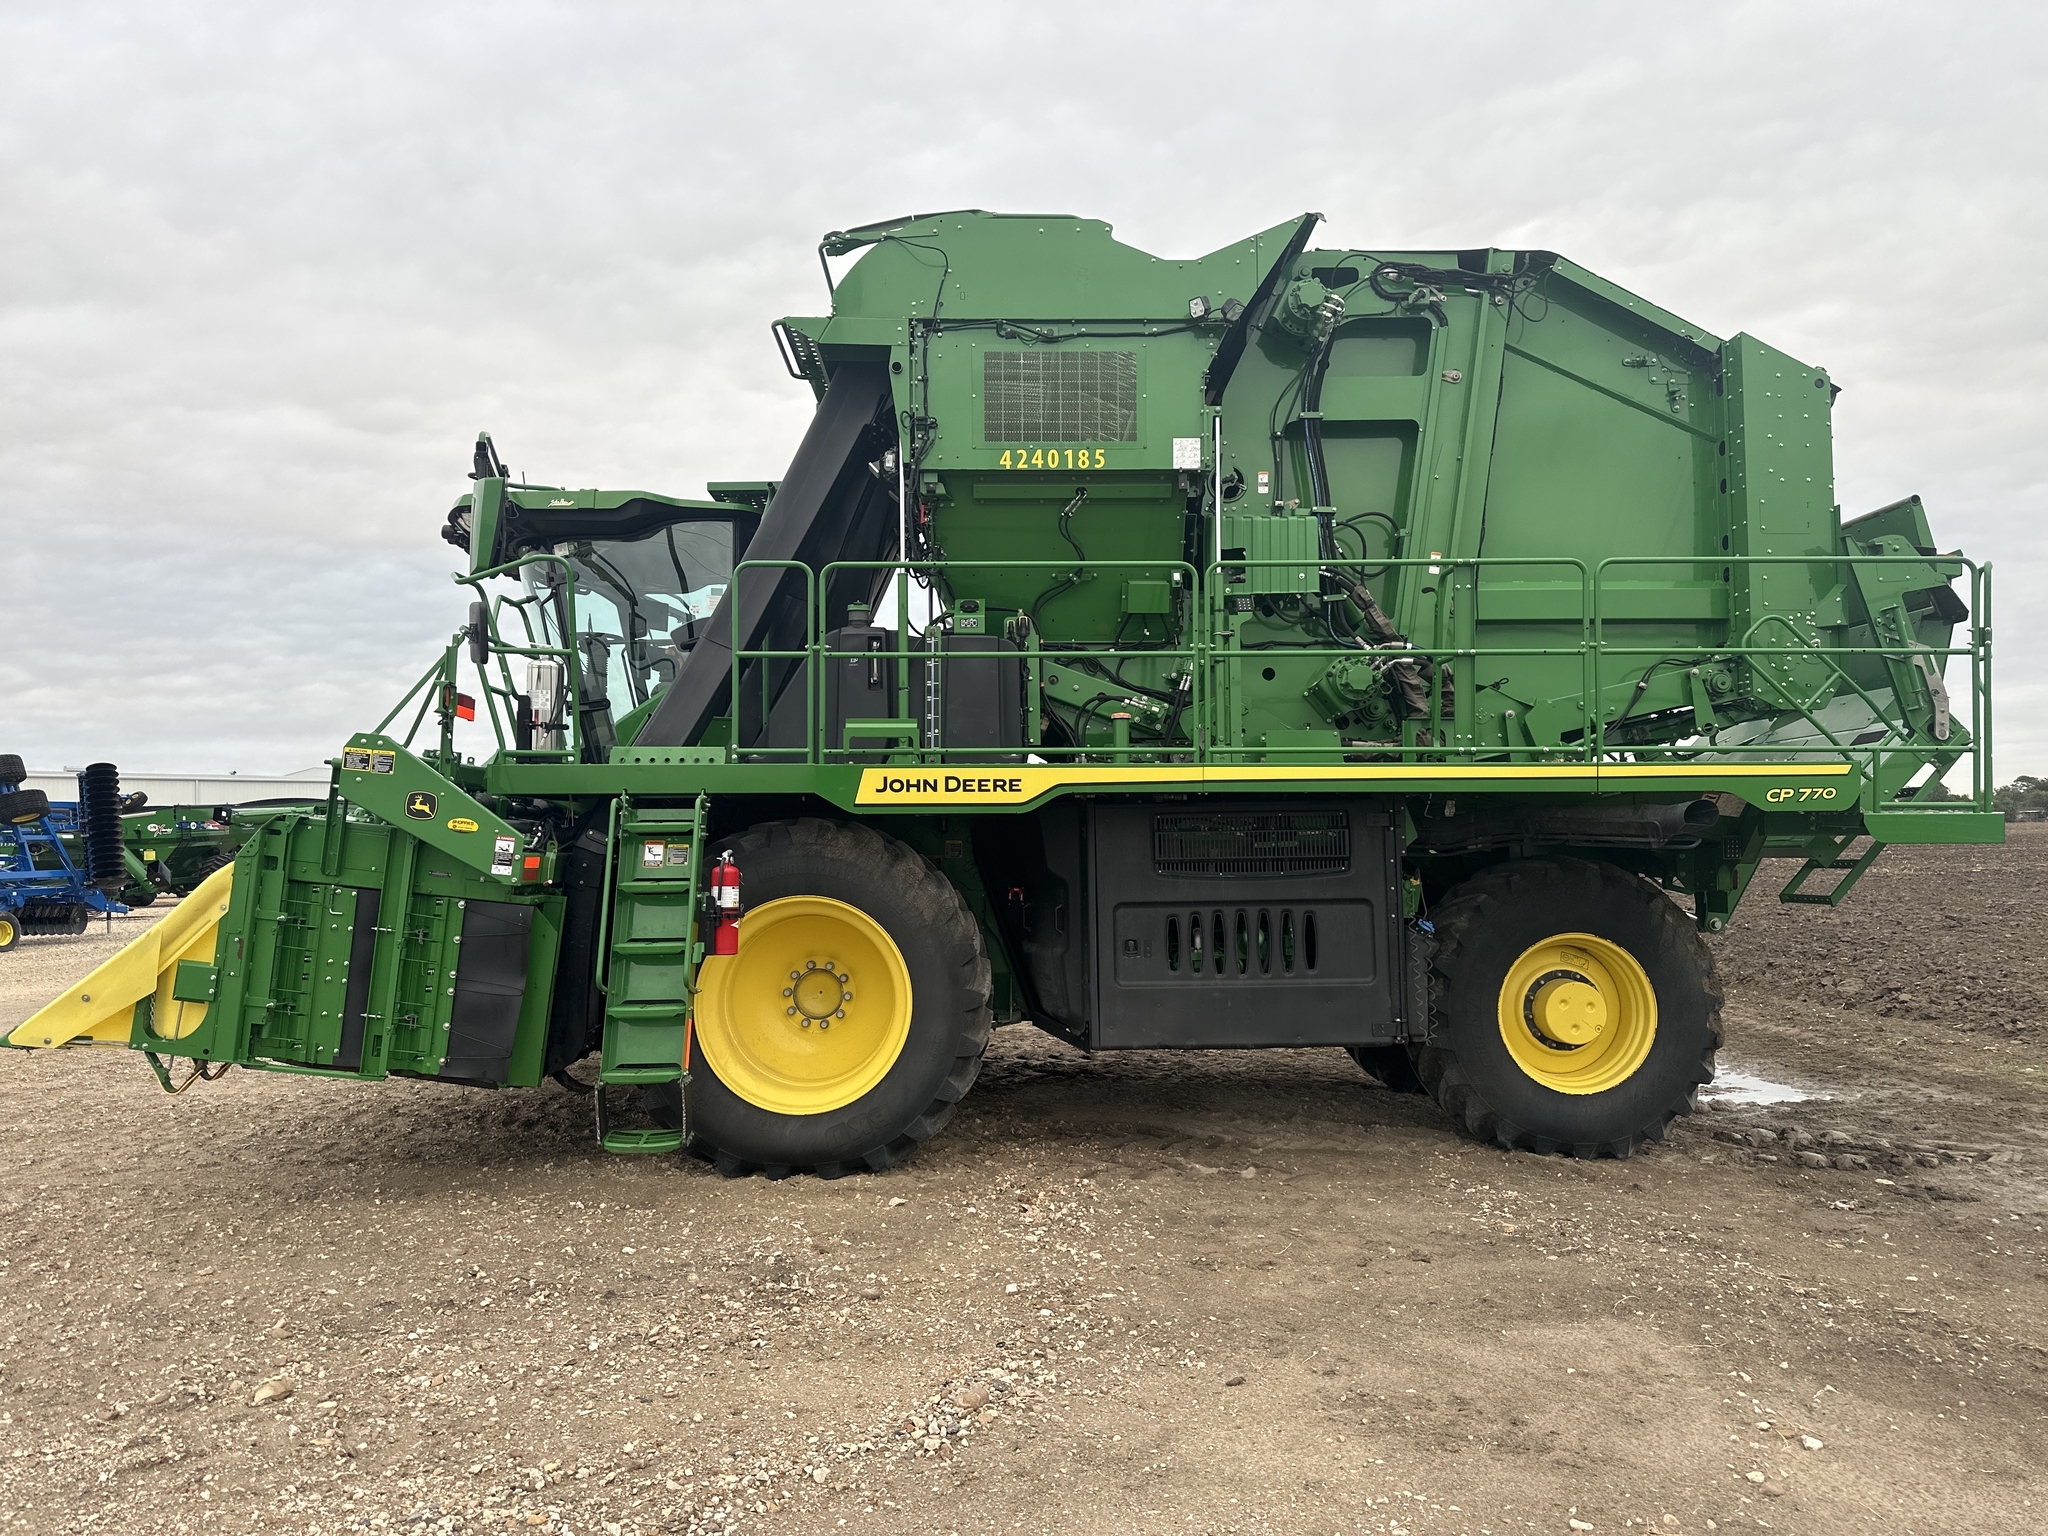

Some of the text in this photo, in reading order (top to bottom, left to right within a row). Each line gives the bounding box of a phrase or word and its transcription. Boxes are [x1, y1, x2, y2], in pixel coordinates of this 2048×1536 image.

[999, 449, 1106, 470] 4240185
[875, 776, 1022, 793] JOHN DEERE
[1765, 787, 1837, 803] CP 770
